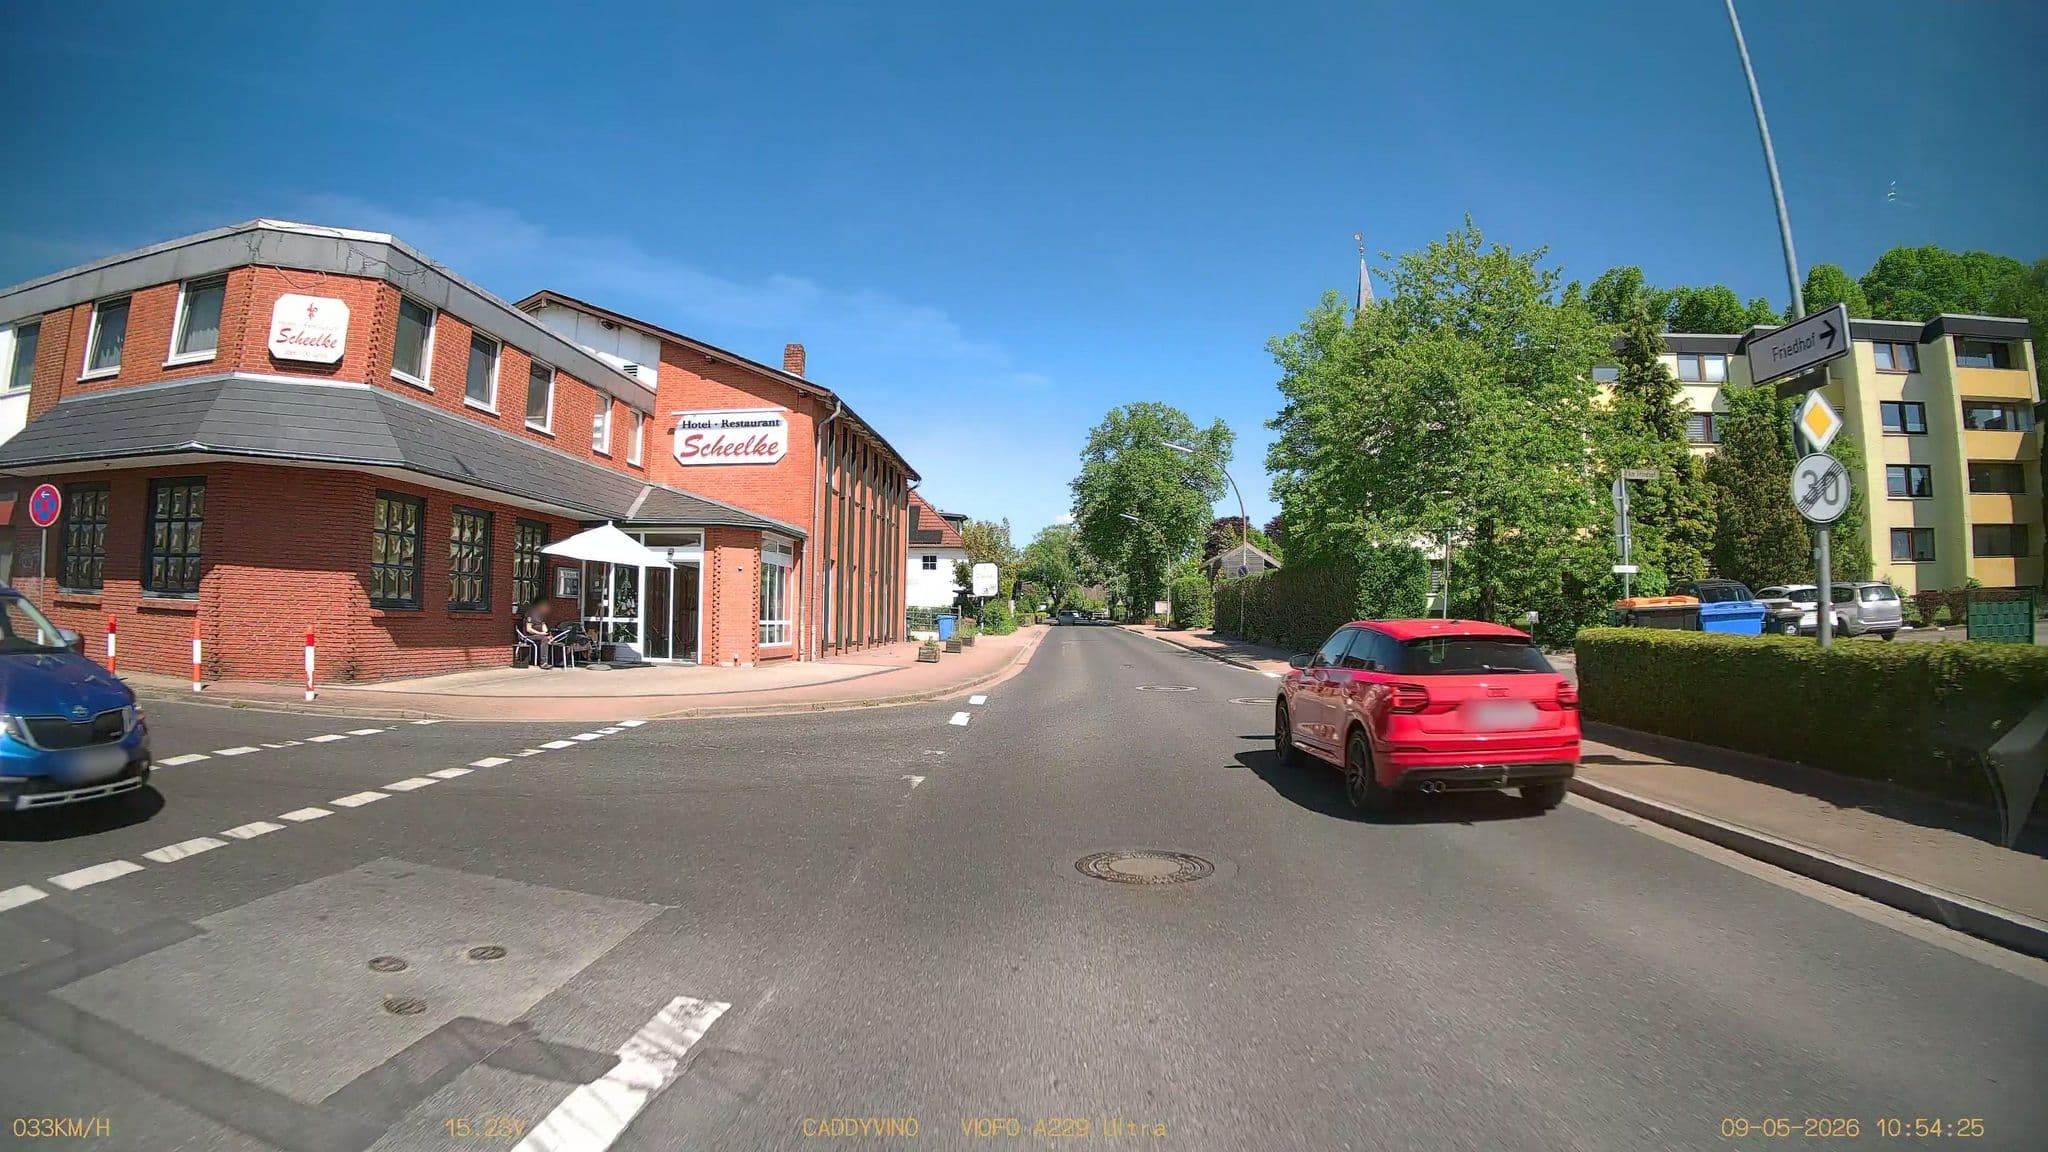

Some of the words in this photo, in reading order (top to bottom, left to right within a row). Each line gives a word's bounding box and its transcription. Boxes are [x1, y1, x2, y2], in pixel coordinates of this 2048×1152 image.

[276, 328, 338, 348] Scheelke
[1772, 332, 1816, 362] Friedhof
[682, 420, 711, 429] Hotel
[721, 419, 780, 428] Restaurant
[680, 434, 779, 458] Scheelke
[1802, 470, 1839, 505] 30
